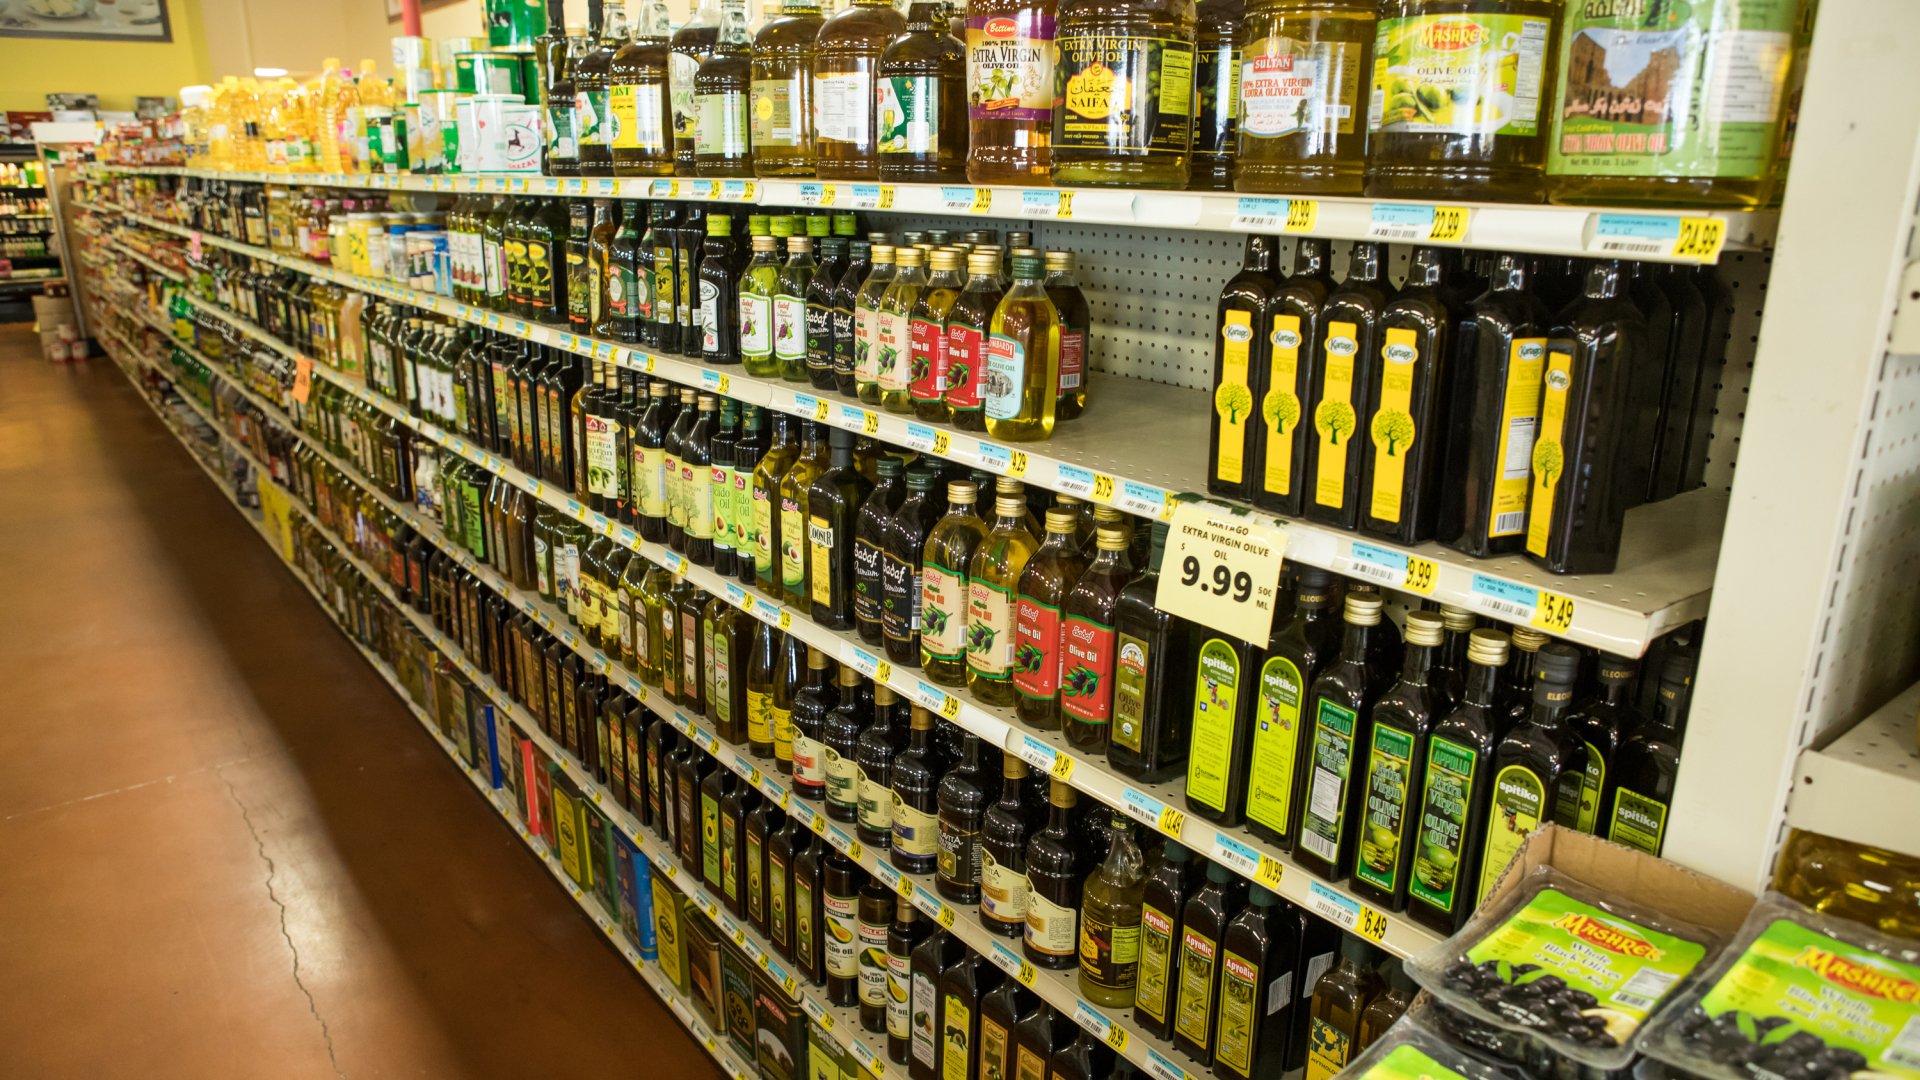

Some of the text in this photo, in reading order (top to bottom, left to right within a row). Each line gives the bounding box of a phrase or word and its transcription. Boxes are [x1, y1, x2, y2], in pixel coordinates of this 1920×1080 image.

[989, 22, 1016, 33] Bettino
[972, 46, 1041, 63] EXTRA VIRGIN
[1064, 40, 1143, 50] EXTRA VIRGIN
[1072, 52, 1103, 62] OLIVE
[1254, 58, 1291, 70] SULTAN
[1417, 67, 1453, 75] OLIVE
[1255, 79, 1279, 88] EXTRA
[1283, 78, 1313, 87] VIRGIN
[1265, 88, 1305, 97] OLIVE OIL
[913, 323, 927, 336] Sadaf
[951, 329, 966, 342] Sadaf
[719, 499, 730, 510] Oil
[740, 505, 749, 517] Oil
[782, 499, 799, 512] Sadaf
[1182, 525, 1270, 557] EXTRA VIRGIN OILVE
[855, 542, 878, 568] Sadaf
[1181, 542, 1228, 561] $ OIL
[883, 557, 906, 583] Sadaf
[925, 569, 943, 585] Sadaf
[1181, 555, 1253, 603] 9.99
[936, 595, 945, 605] Oil
[971, 585, 990, 601] Sadaf
[1020, 604, 1039, 622] Sadaf
[1256, 599, 1268, 611] ML
[1544, 593, 1573, 628] $5.49
[983, 609, 992, 622] Oil
[1018, 623, 1041, 641] Olive Oil
[1072, 625, 1095, 644] Sadaf
[1069, 644, 1097, 663] Olive Oil
[1202, 655, 1235, 674] spitiko
[1264, 673, 1298, 693] spitiko
[1119, 692, 1141, 710] Olive
[1123, 703, 1136, 717] Oil
[1318, 744, 1345, 765] OLIVE
[1432, 751, 1470, 776] APPOLLO
[1321, 756, 1337, 773] OIL
[1376, 761, 1401, 784] Extra
[1373, 775, 1402, 800] Virgin
[1434, 773, 1462, 799] Extra
[1499, 781, 1538, 803] spitiko
[1369, 795, 1400, 820] OLIVE
[1430, 789, 1462, 815] Virgin
[1373, 811, 1392, 830] OIL
[1425, 813, 1459, 839] OLIVE
[1618, 806, 1658, 829] spitiko
[1429, 830, 1449, 849] OIL
[1364, 906, 1387, 940] $6.49
[1553, 912, 1666, 960] MASHREK
[1544, 942, 1623, 980] Black Olives
[1571, 942, 1612, 965] Whole
[1821, 985, 1874, 1015] Whole
[1311, 1056, 1337, 1075] MYTHOLO
